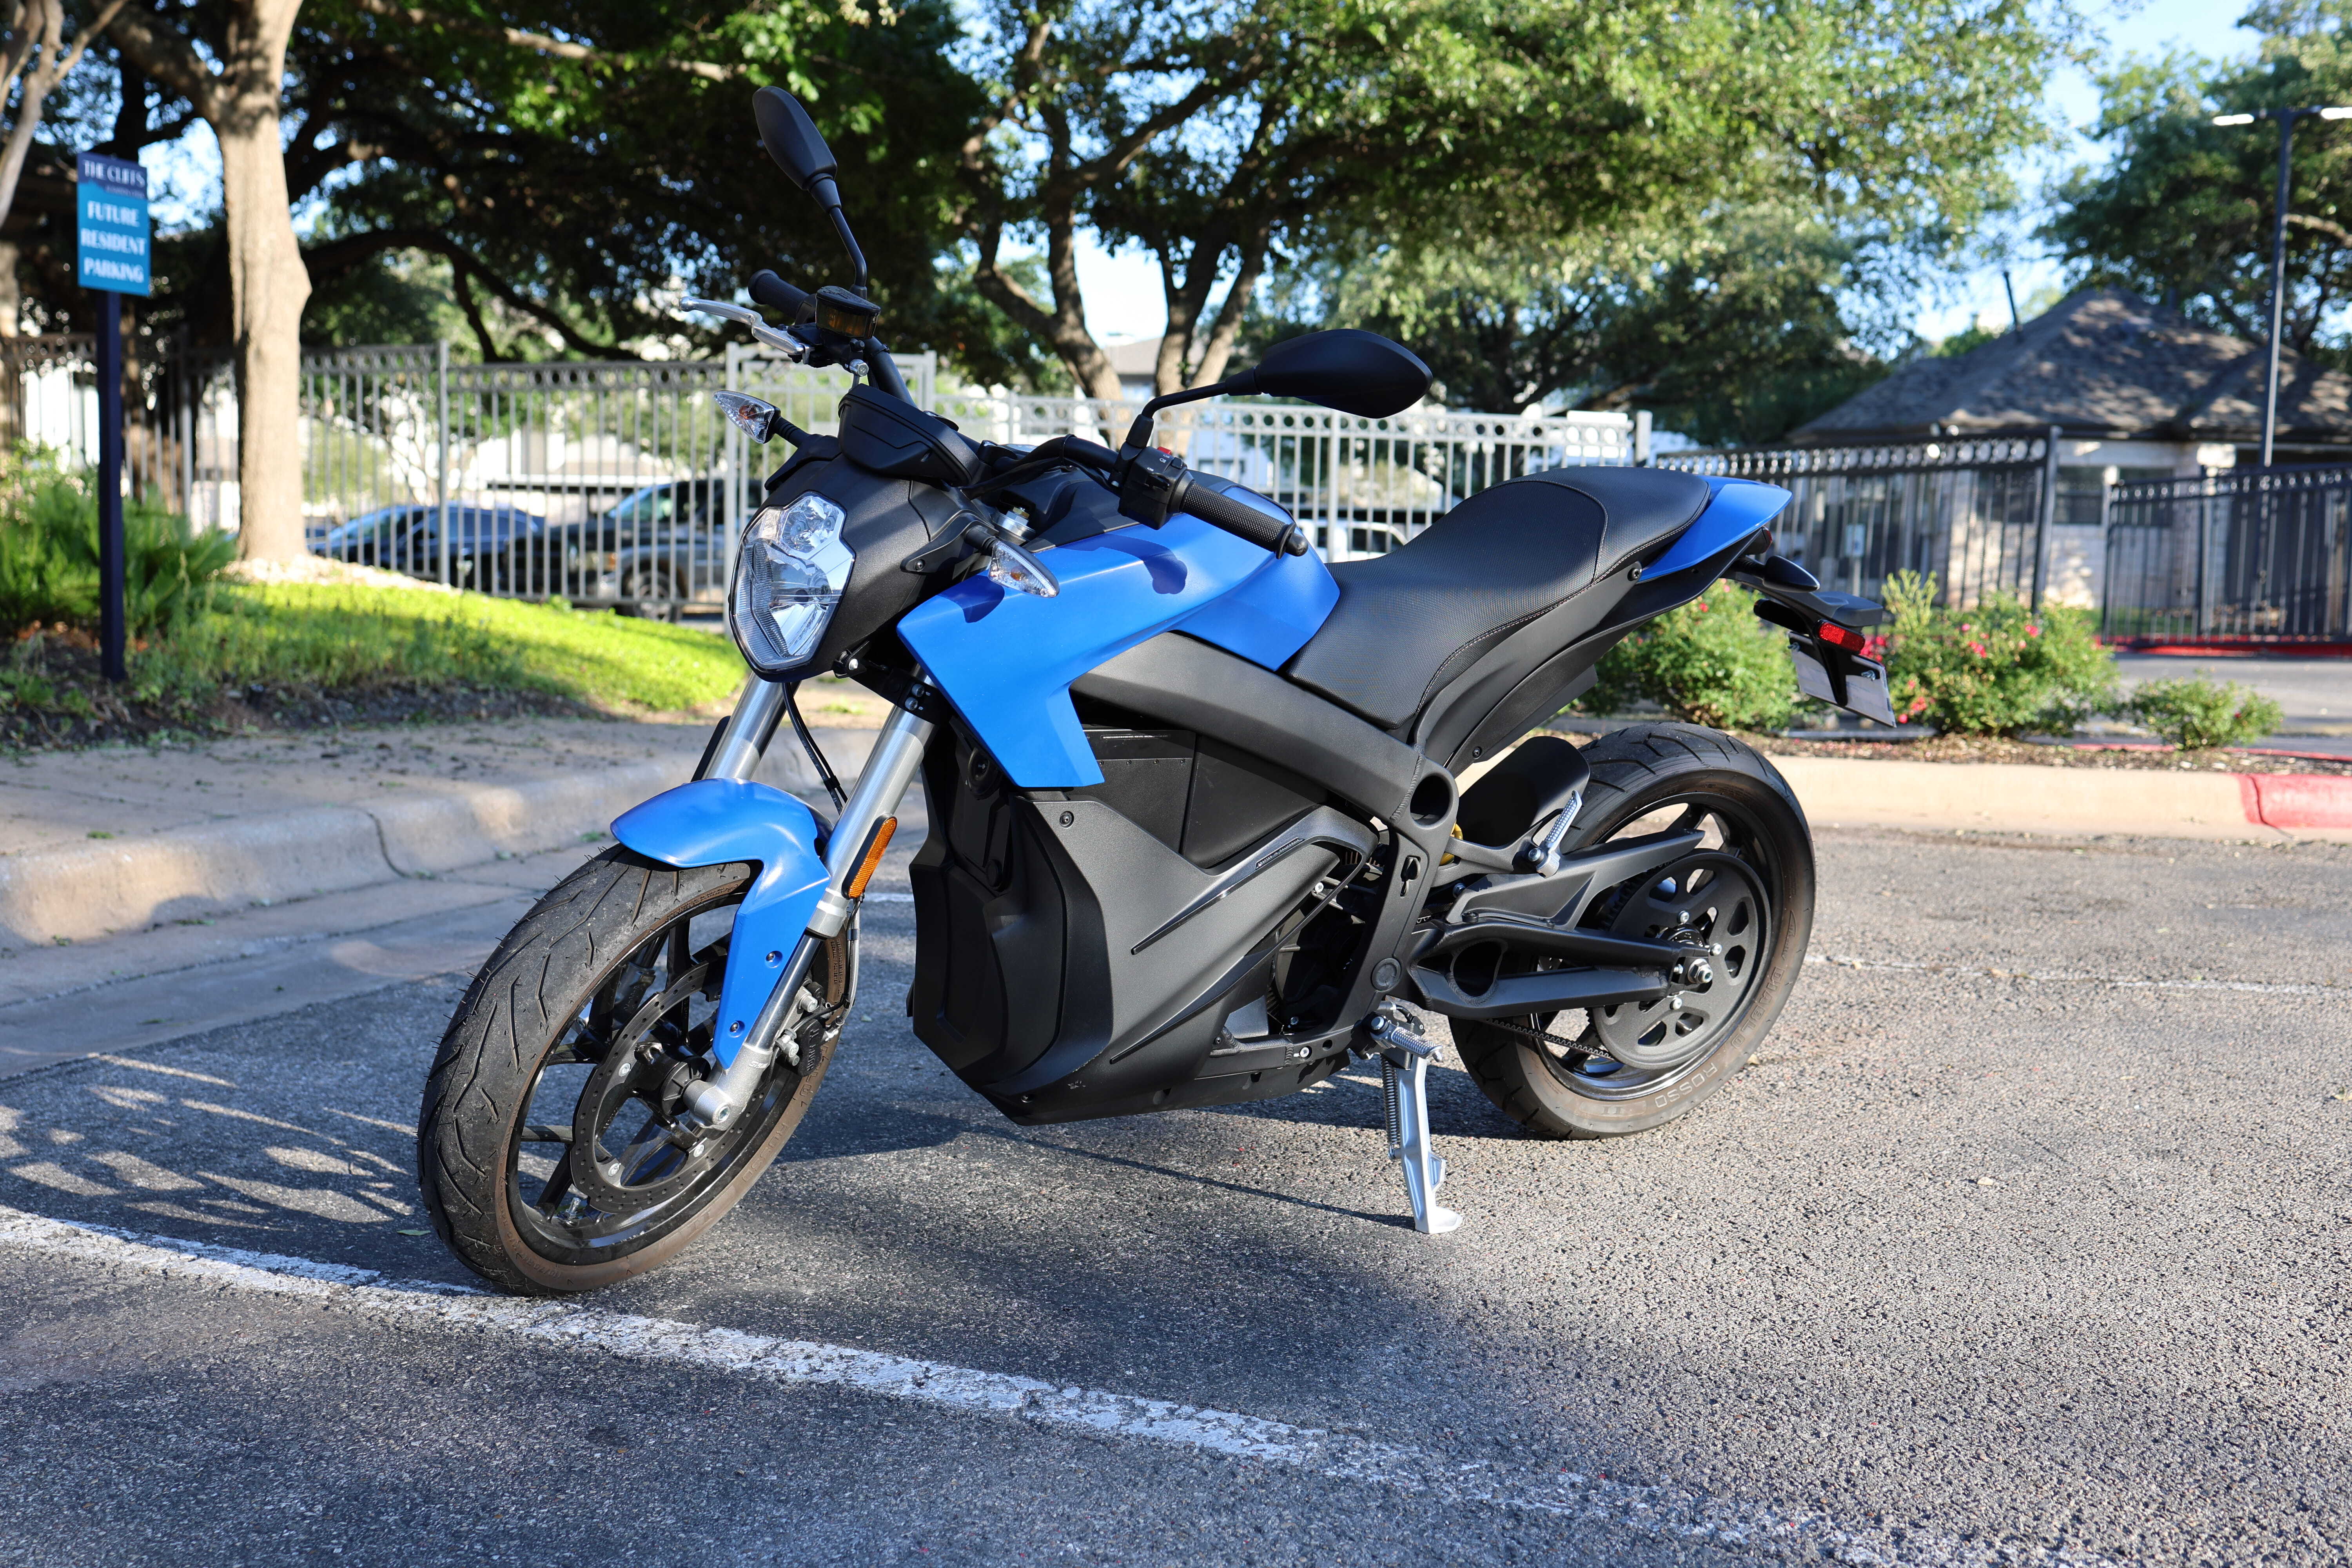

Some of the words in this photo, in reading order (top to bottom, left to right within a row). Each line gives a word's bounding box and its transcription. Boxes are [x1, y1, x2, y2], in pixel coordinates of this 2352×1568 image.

[87, 200, 140, 228] FUTURE
[80, 227, 147, 256] RESIDENT
[83, 256, 144, 283] PARKING
[1731, 966, 1785, 1049] DIABLO
[1654, 1062, 1719, 1109] ROSSO
